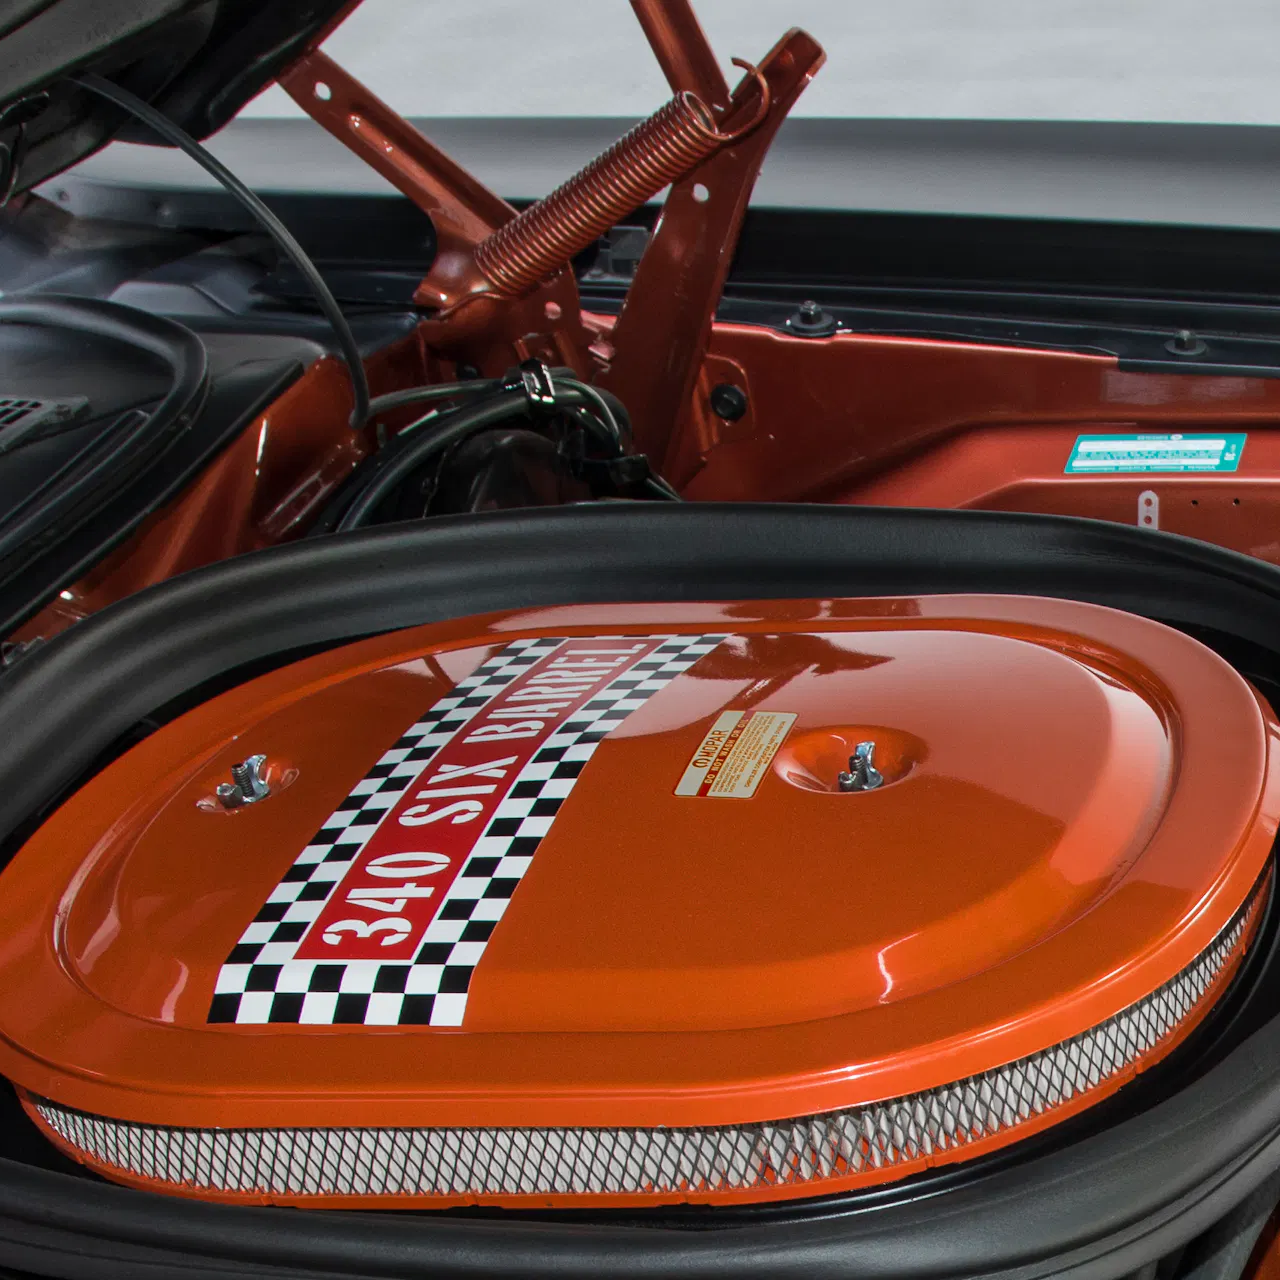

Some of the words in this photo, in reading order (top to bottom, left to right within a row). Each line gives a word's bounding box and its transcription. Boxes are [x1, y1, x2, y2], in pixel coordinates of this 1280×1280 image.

[322, 850, 452, 948] 340
[397, 763, 517, 826] SIX
[470, 642, 654, 744] BARREL
[700, 729, 729, 759] MOPAR
